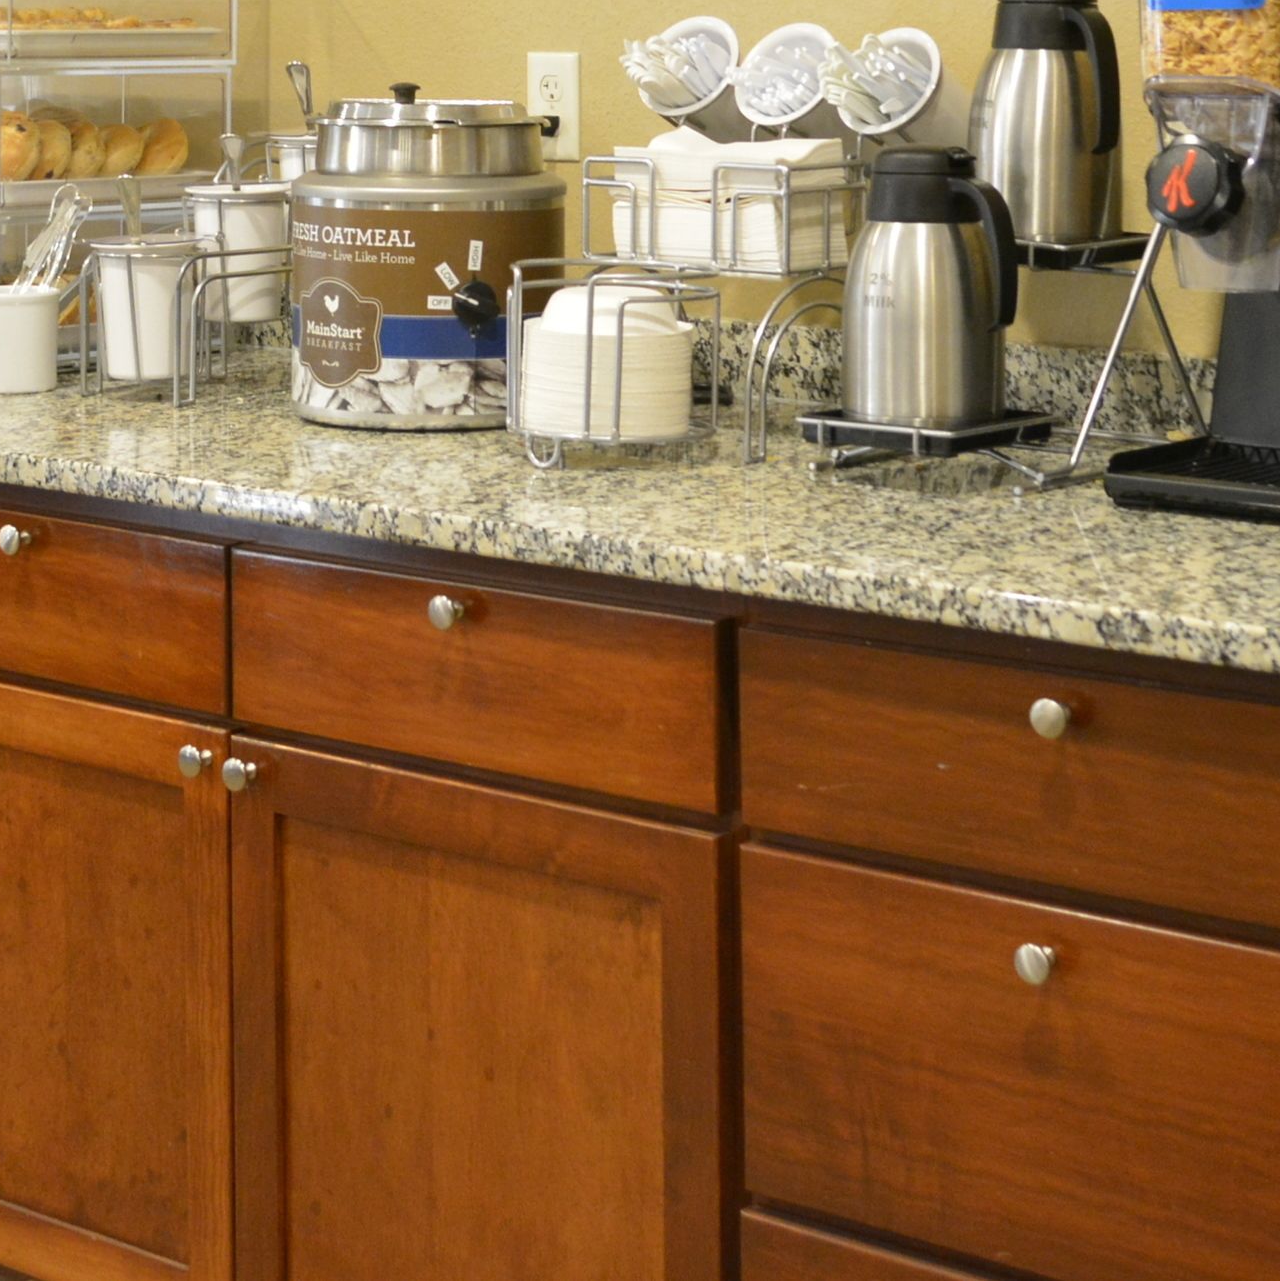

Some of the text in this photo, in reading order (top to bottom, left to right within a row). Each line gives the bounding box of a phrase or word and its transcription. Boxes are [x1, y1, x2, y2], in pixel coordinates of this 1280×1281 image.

[321, 225, 416, 248] OATMEAL
[333, 248, 352, 262] Live
[355, 250, 378, 264] Like
[380, 251, 416, 265] Home
[440, 267, 456, 287] LOW
[431, 298, 450, 307] OFF
[306, 319, 363, 340] MainStart
[306, 337, 362, 352] BREAKFAST
